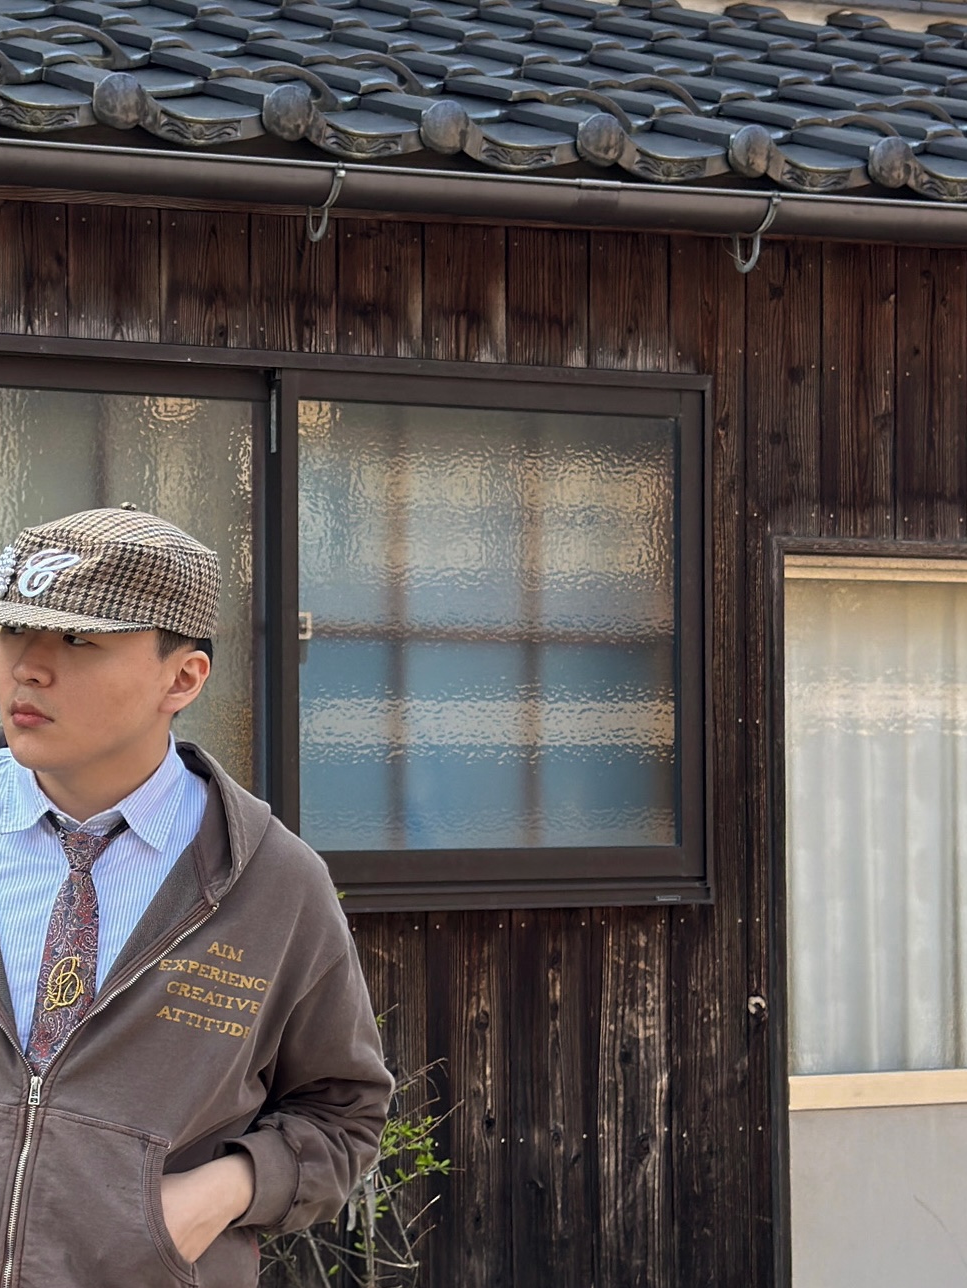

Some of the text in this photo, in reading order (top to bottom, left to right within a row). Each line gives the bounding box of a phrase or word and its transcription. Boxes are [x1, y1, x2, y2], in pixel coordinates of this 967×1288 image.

[207, 941, 244, 962] AIM
[158, 959, 273, 992] EXPERIENC
[166, 981, 262, 1016] CREATIVE
